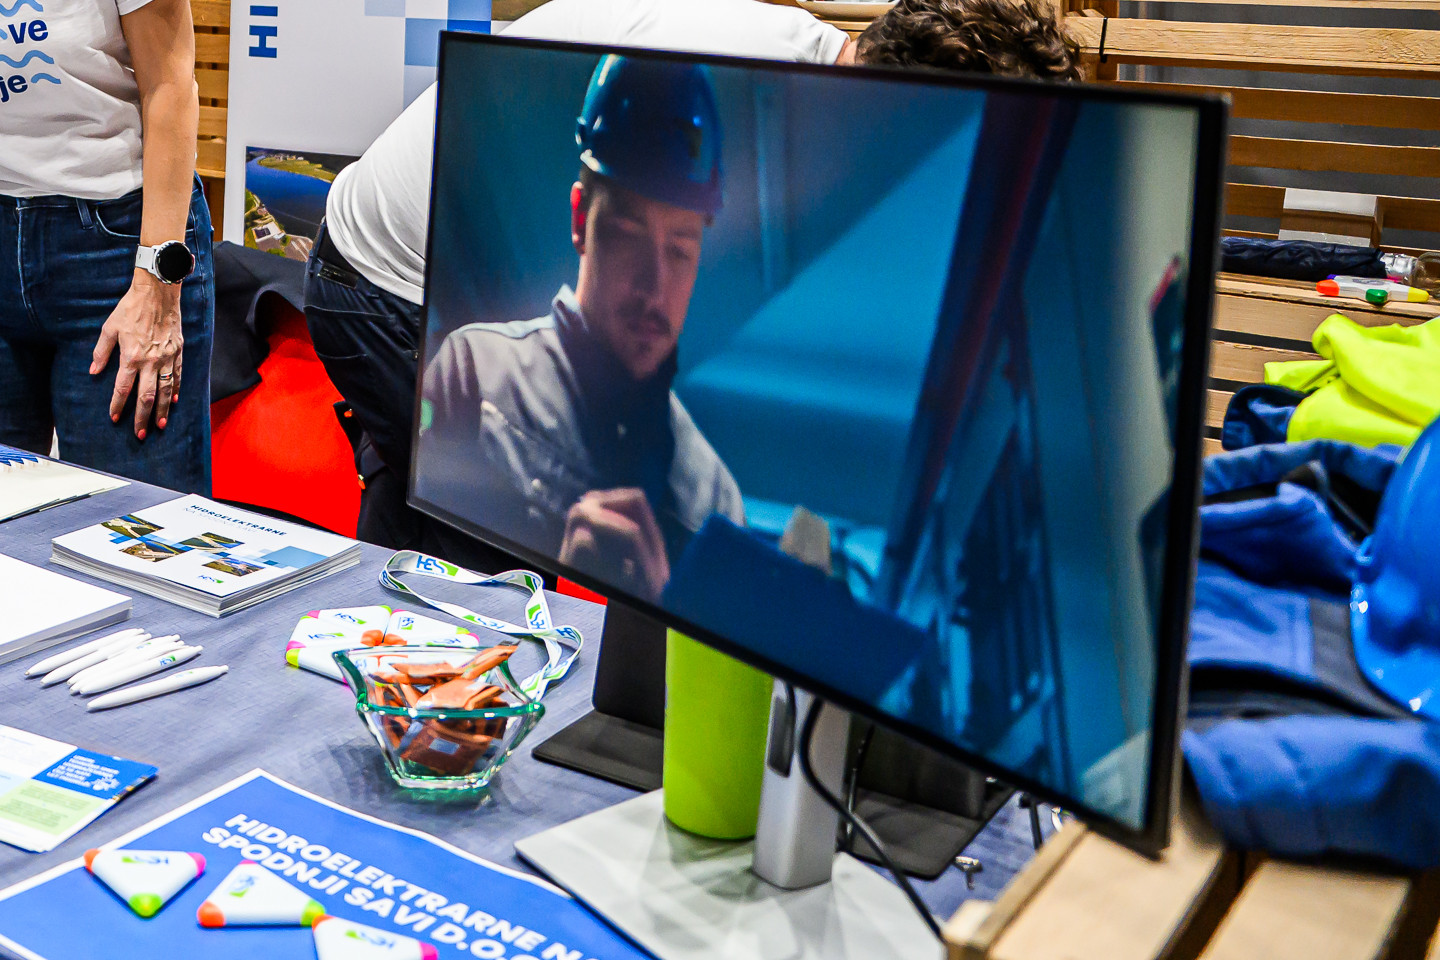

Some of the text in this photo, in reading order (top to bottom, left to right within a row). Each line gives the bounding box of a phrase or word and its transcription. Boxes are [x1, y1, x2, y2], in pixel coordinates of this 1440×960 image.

[7, 19, 49, 45] ve
[190, 504, 287, 536] HIDROELEKTRARNE
[202, 826, 350, 897] SPODNJI
[343, 888, 438, 936] SAVI
[224, 813, 601, 960] HIDROELEKTRARNE N
